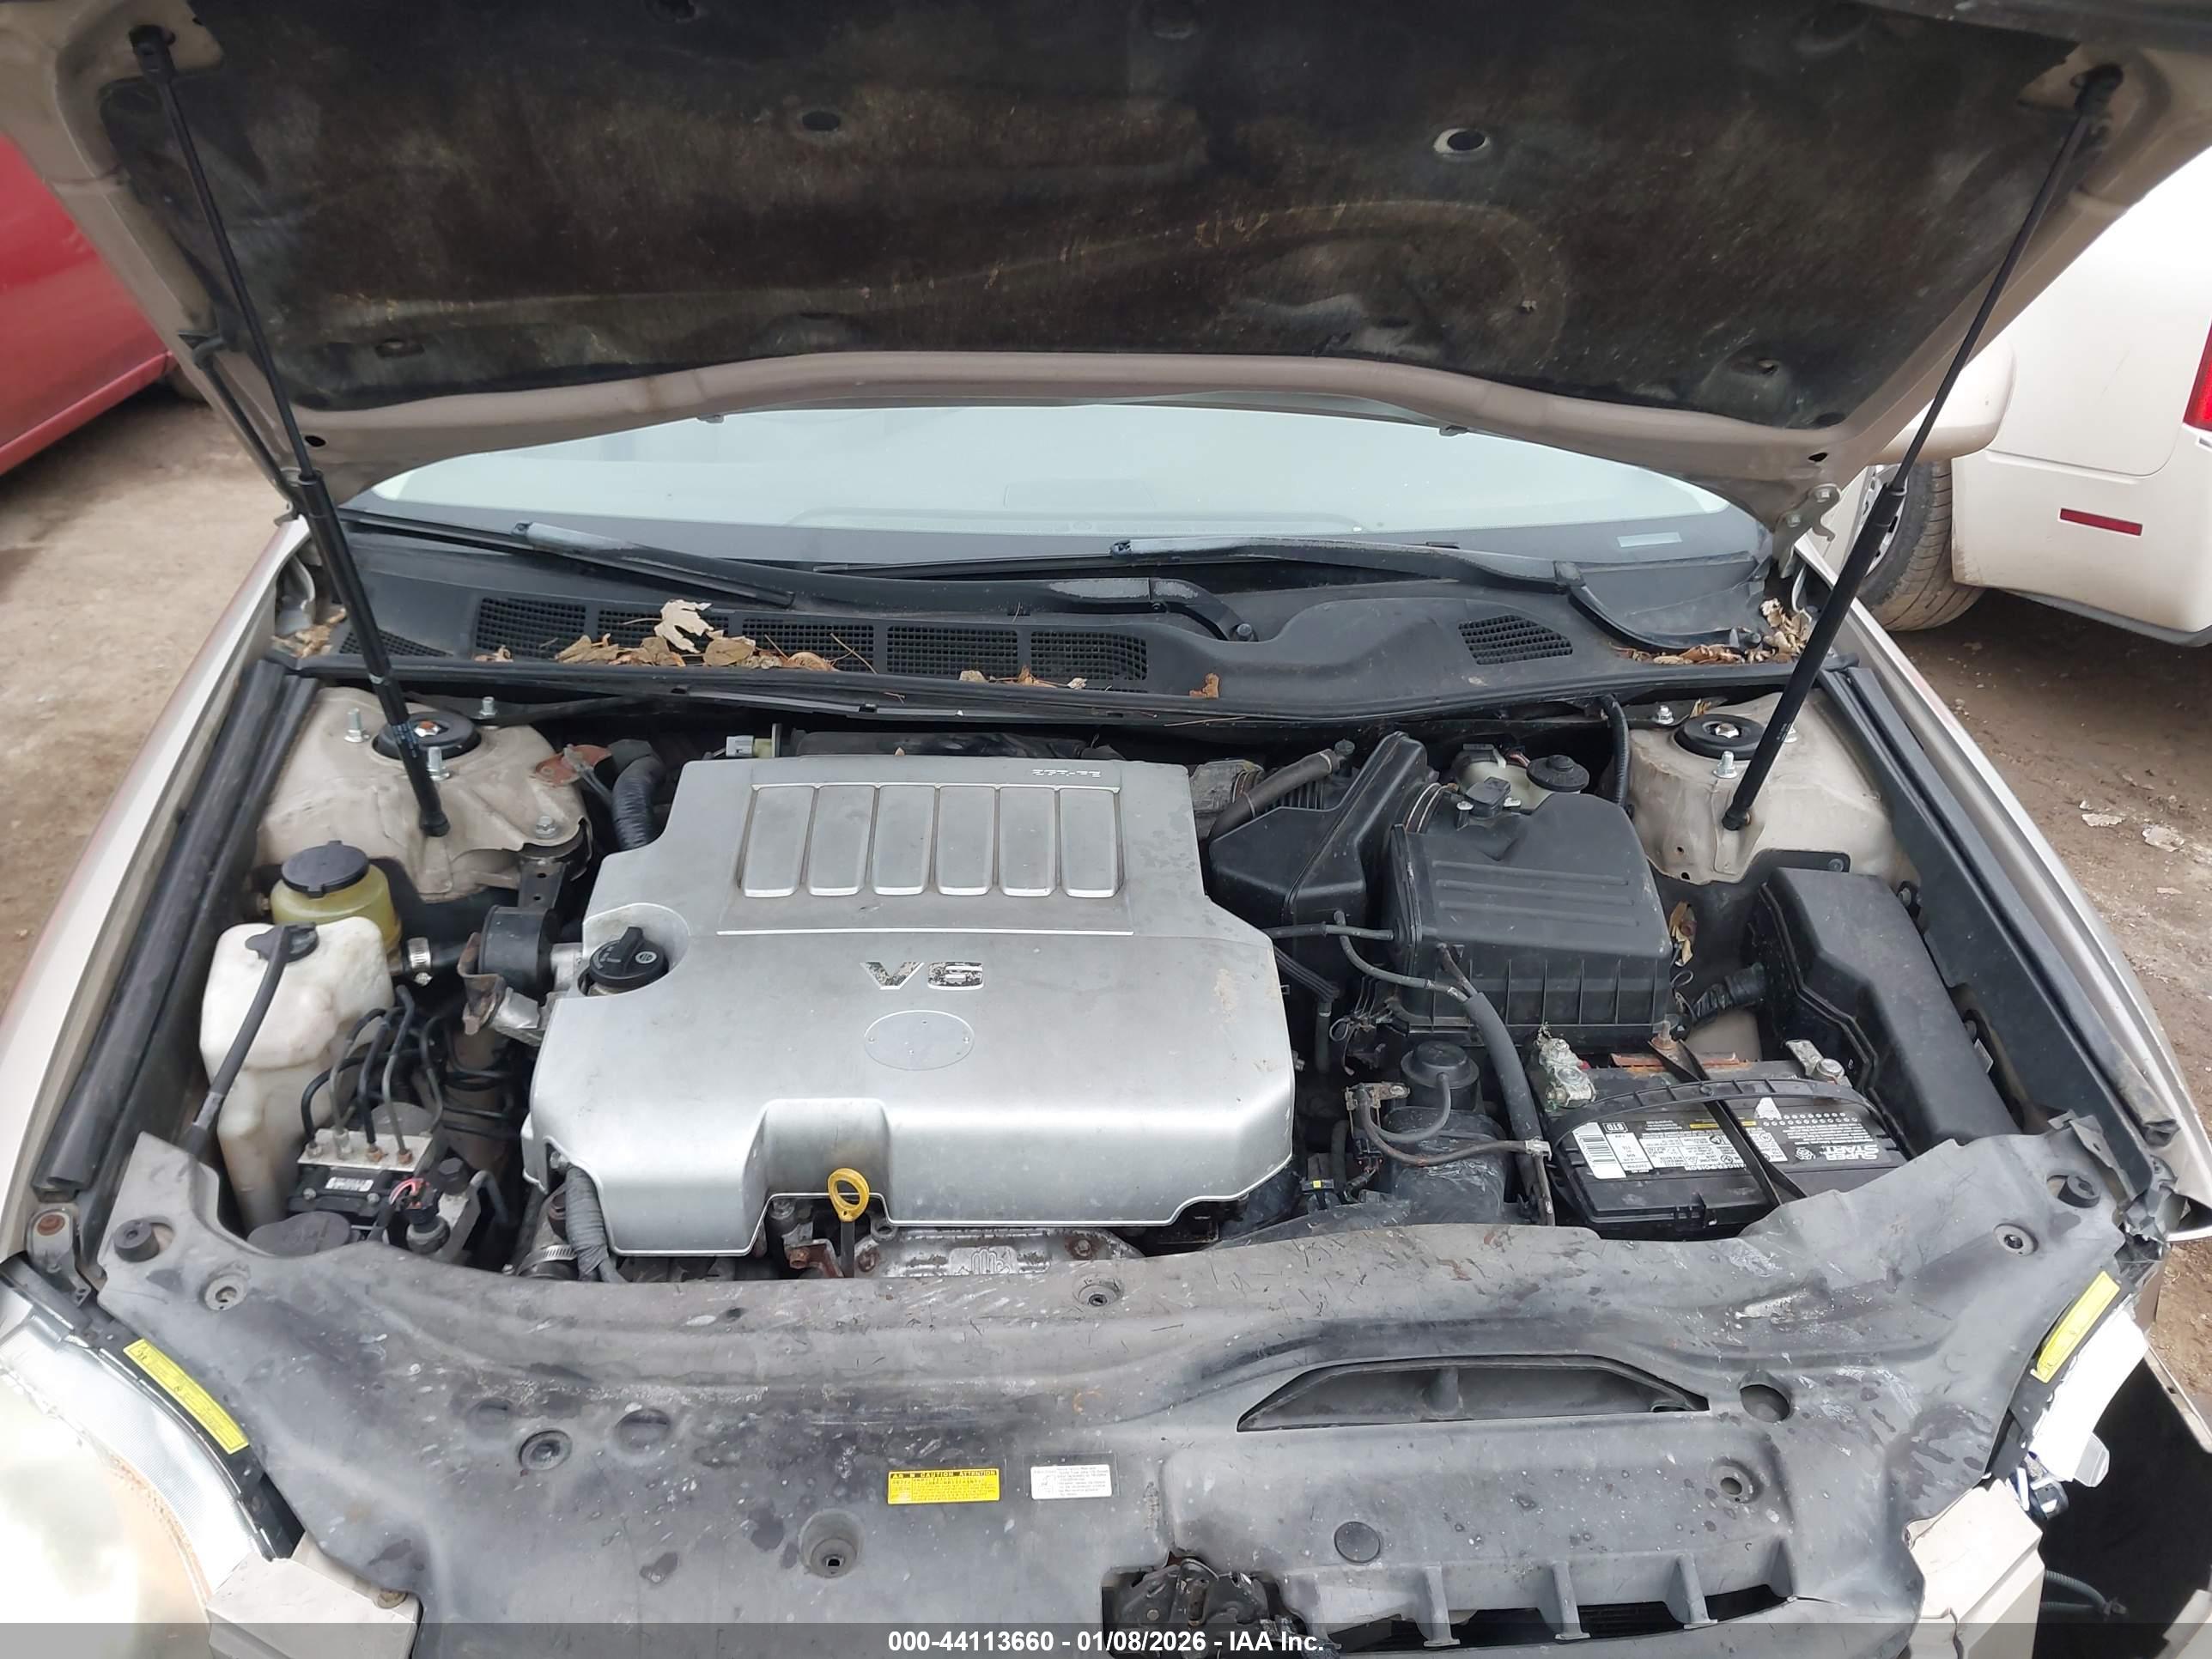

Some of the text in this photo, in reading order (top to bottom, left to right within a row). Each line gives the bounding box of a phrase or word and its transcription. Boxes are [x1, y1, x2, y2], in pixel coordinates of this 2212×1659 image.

[860, 961, 985, 990] V6
[1827, 1145, 1879, 1154] START
[1685, 1162, 1747, 1171] ANGER/POISON
